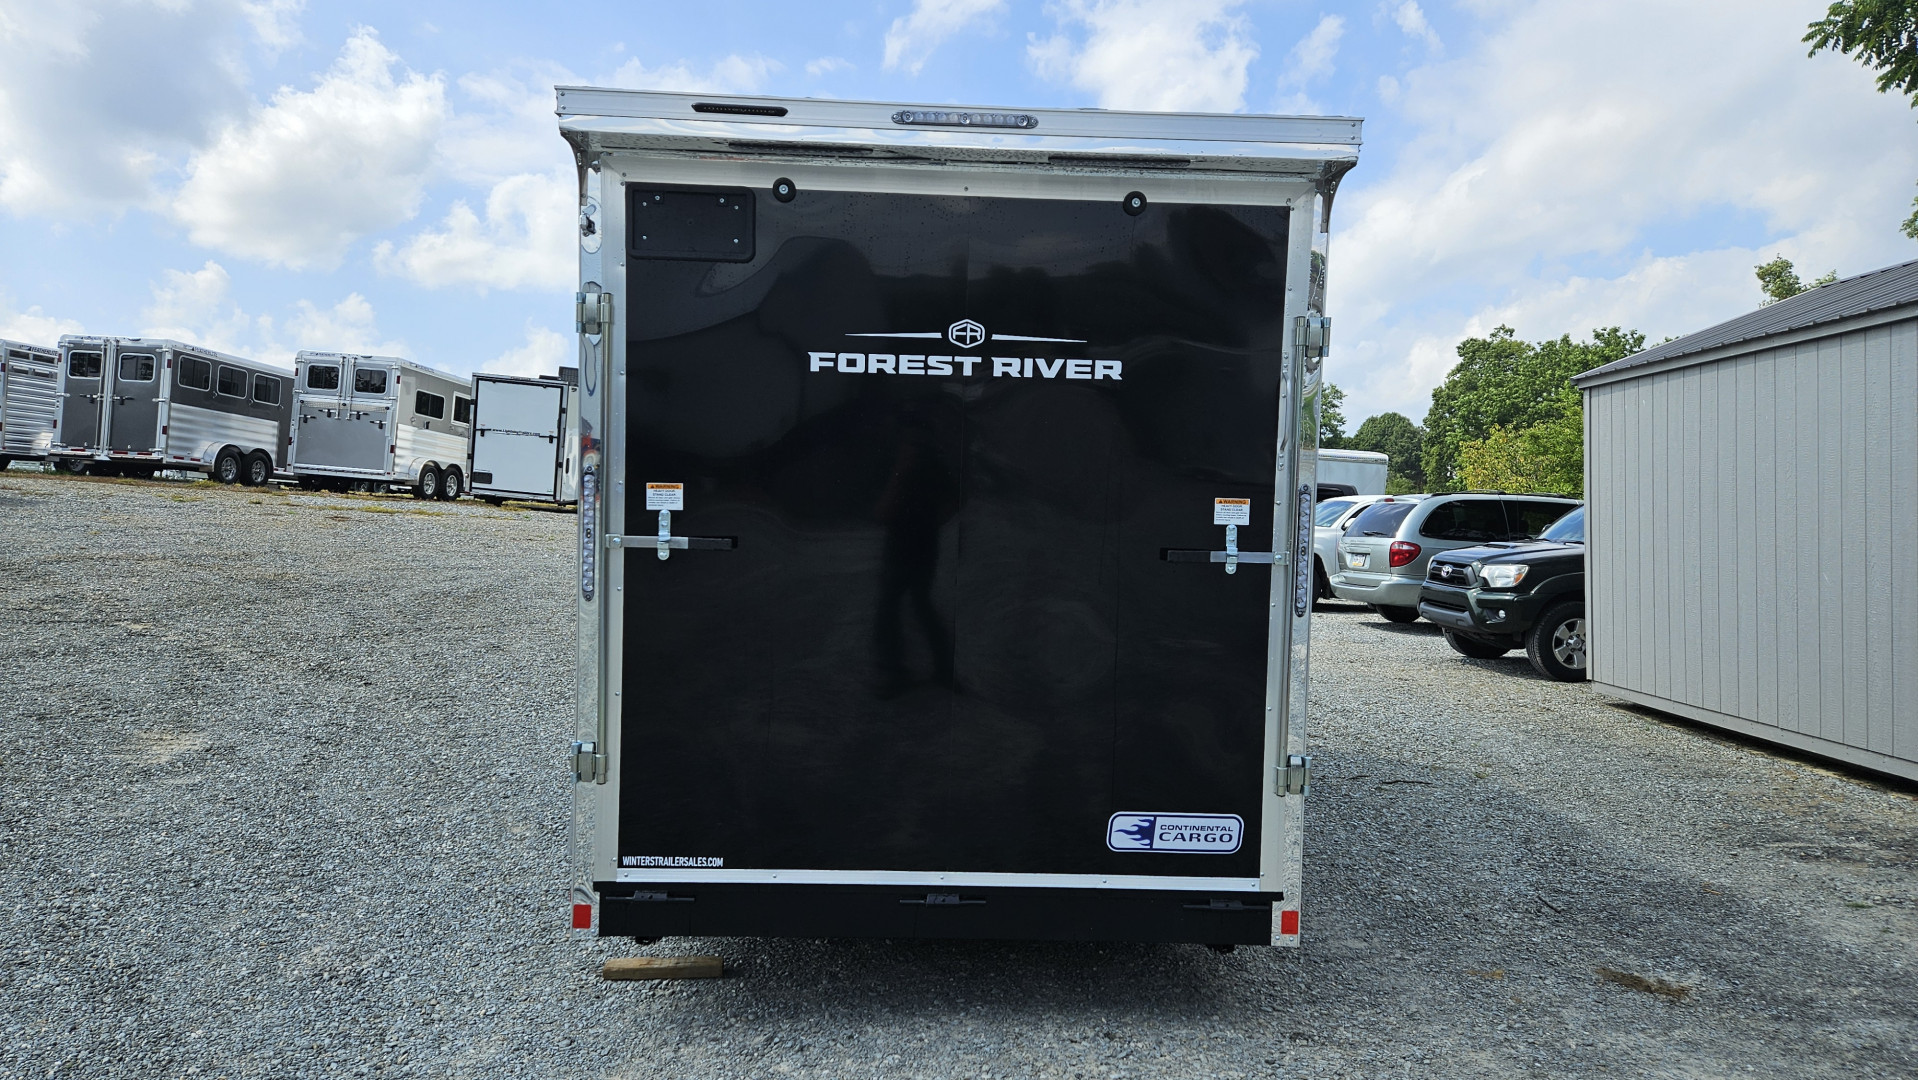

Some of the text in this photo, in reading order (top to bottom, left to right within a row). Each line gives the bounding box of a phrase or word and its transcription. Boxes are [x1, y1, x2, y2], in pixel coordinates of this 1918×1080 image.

[807, 352, 1123, 380] FOREST RIVER
[1160, 824, 1233, 832] CONTINENTAL
[1159, 832, 1233, 843] CARGO
[622, 856, 723, 867] WINTERSTRAILERSALES.COM
